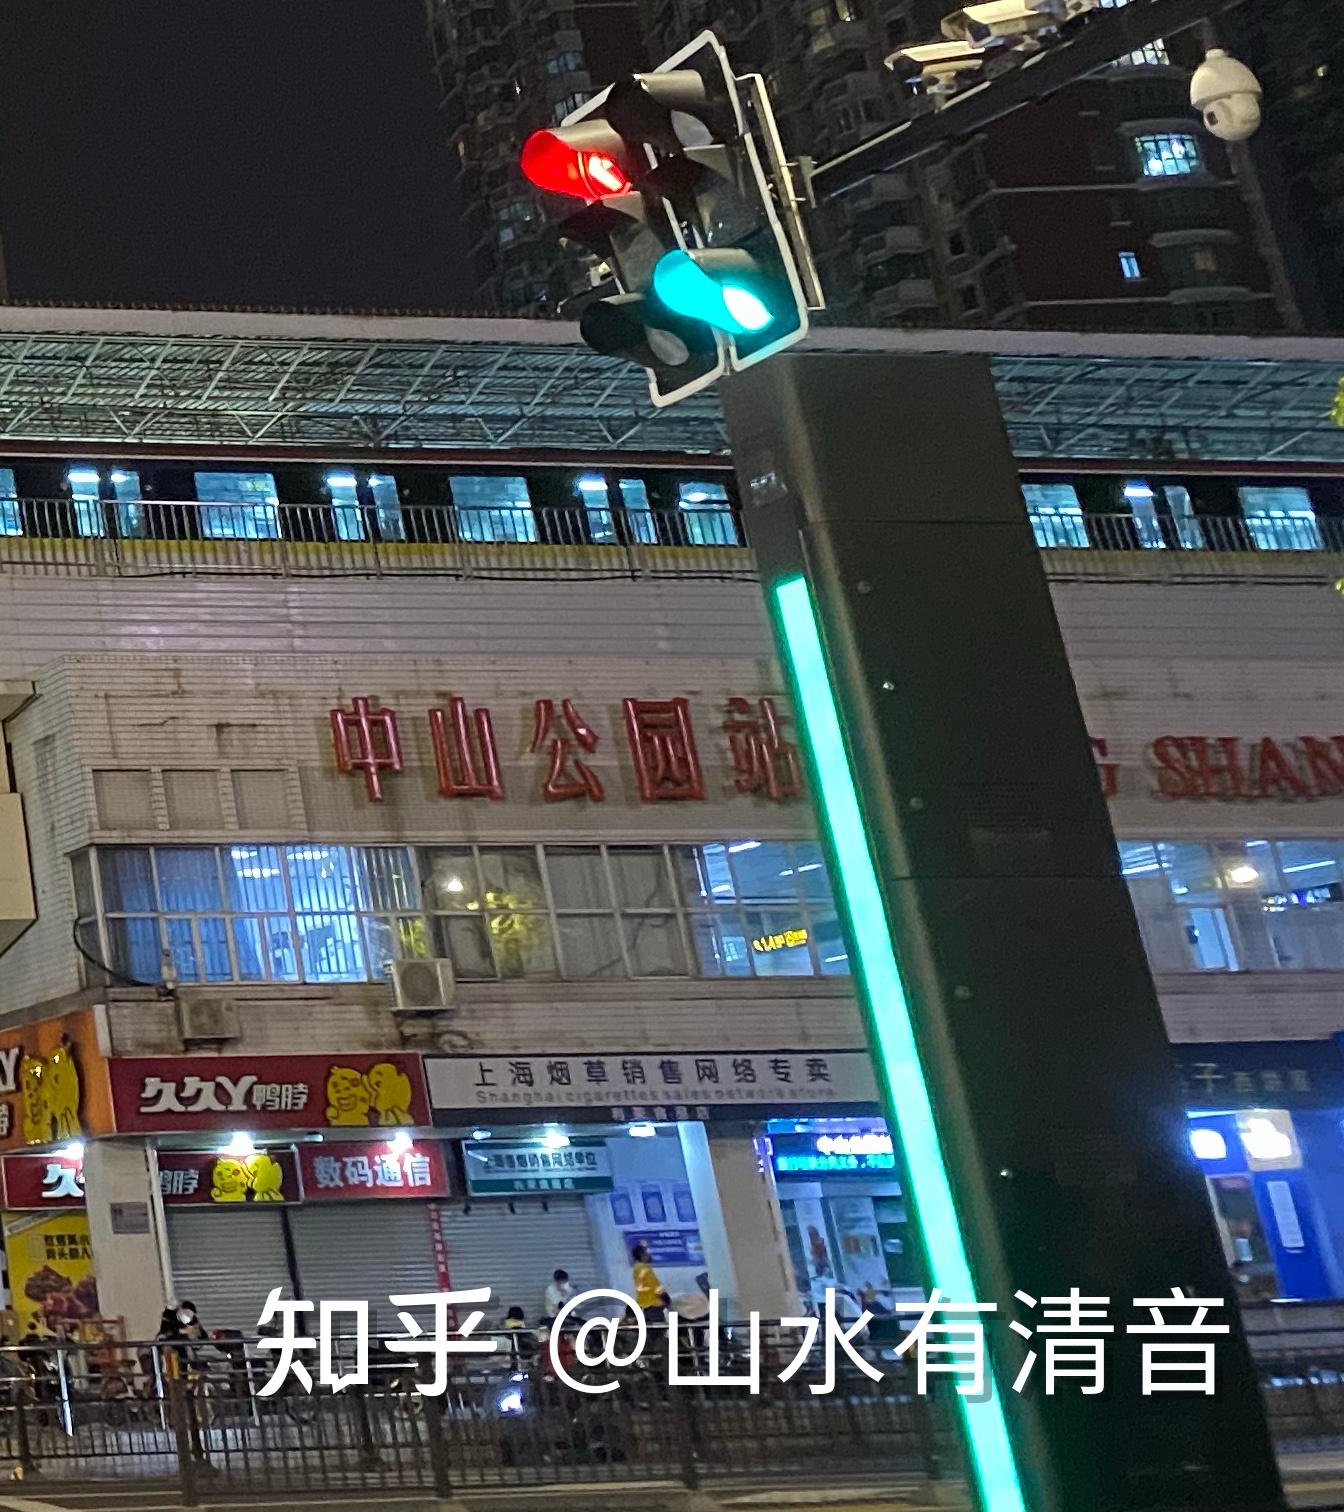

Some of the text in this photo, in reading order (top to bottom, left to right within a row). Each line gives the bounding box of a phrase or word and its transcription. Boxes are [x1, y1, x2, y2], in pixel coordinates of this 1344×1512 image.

[330, 696, 806, 801] 中山公园站
[474, 1058, 832, 1087] 上海烟草销售网络专卖
[314, 1153, 432, 1189] 数码通信
